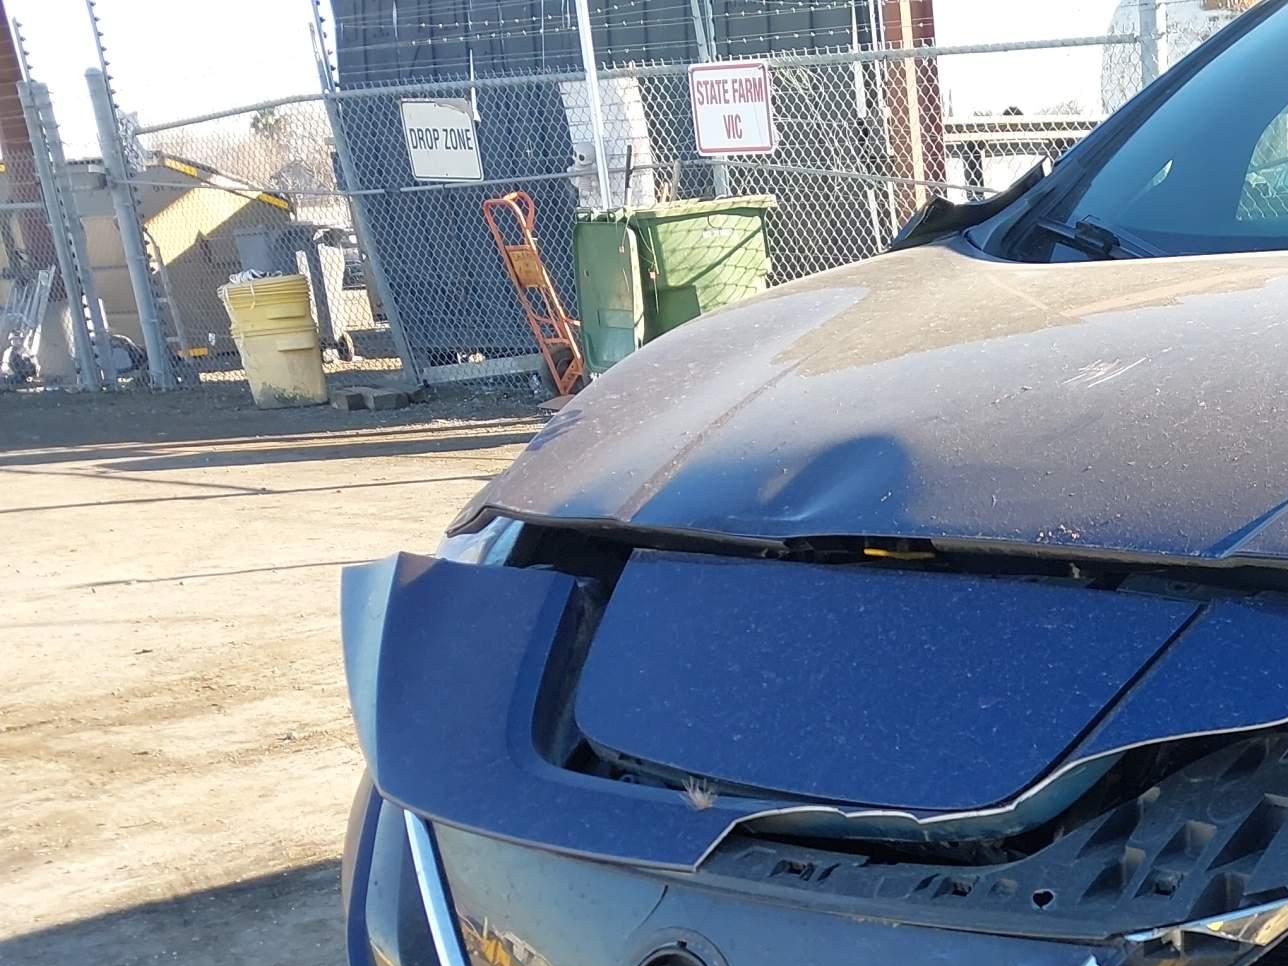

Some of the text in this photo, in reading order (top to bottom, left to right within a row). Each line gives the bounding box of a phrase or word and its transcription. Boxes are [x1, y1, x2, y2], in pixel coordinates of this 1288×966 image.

[696, 76, 764, 106] STATE FARM
[408, 127, 474, 151] DROP ZONE
[723, 113, 743, 140] VIC
